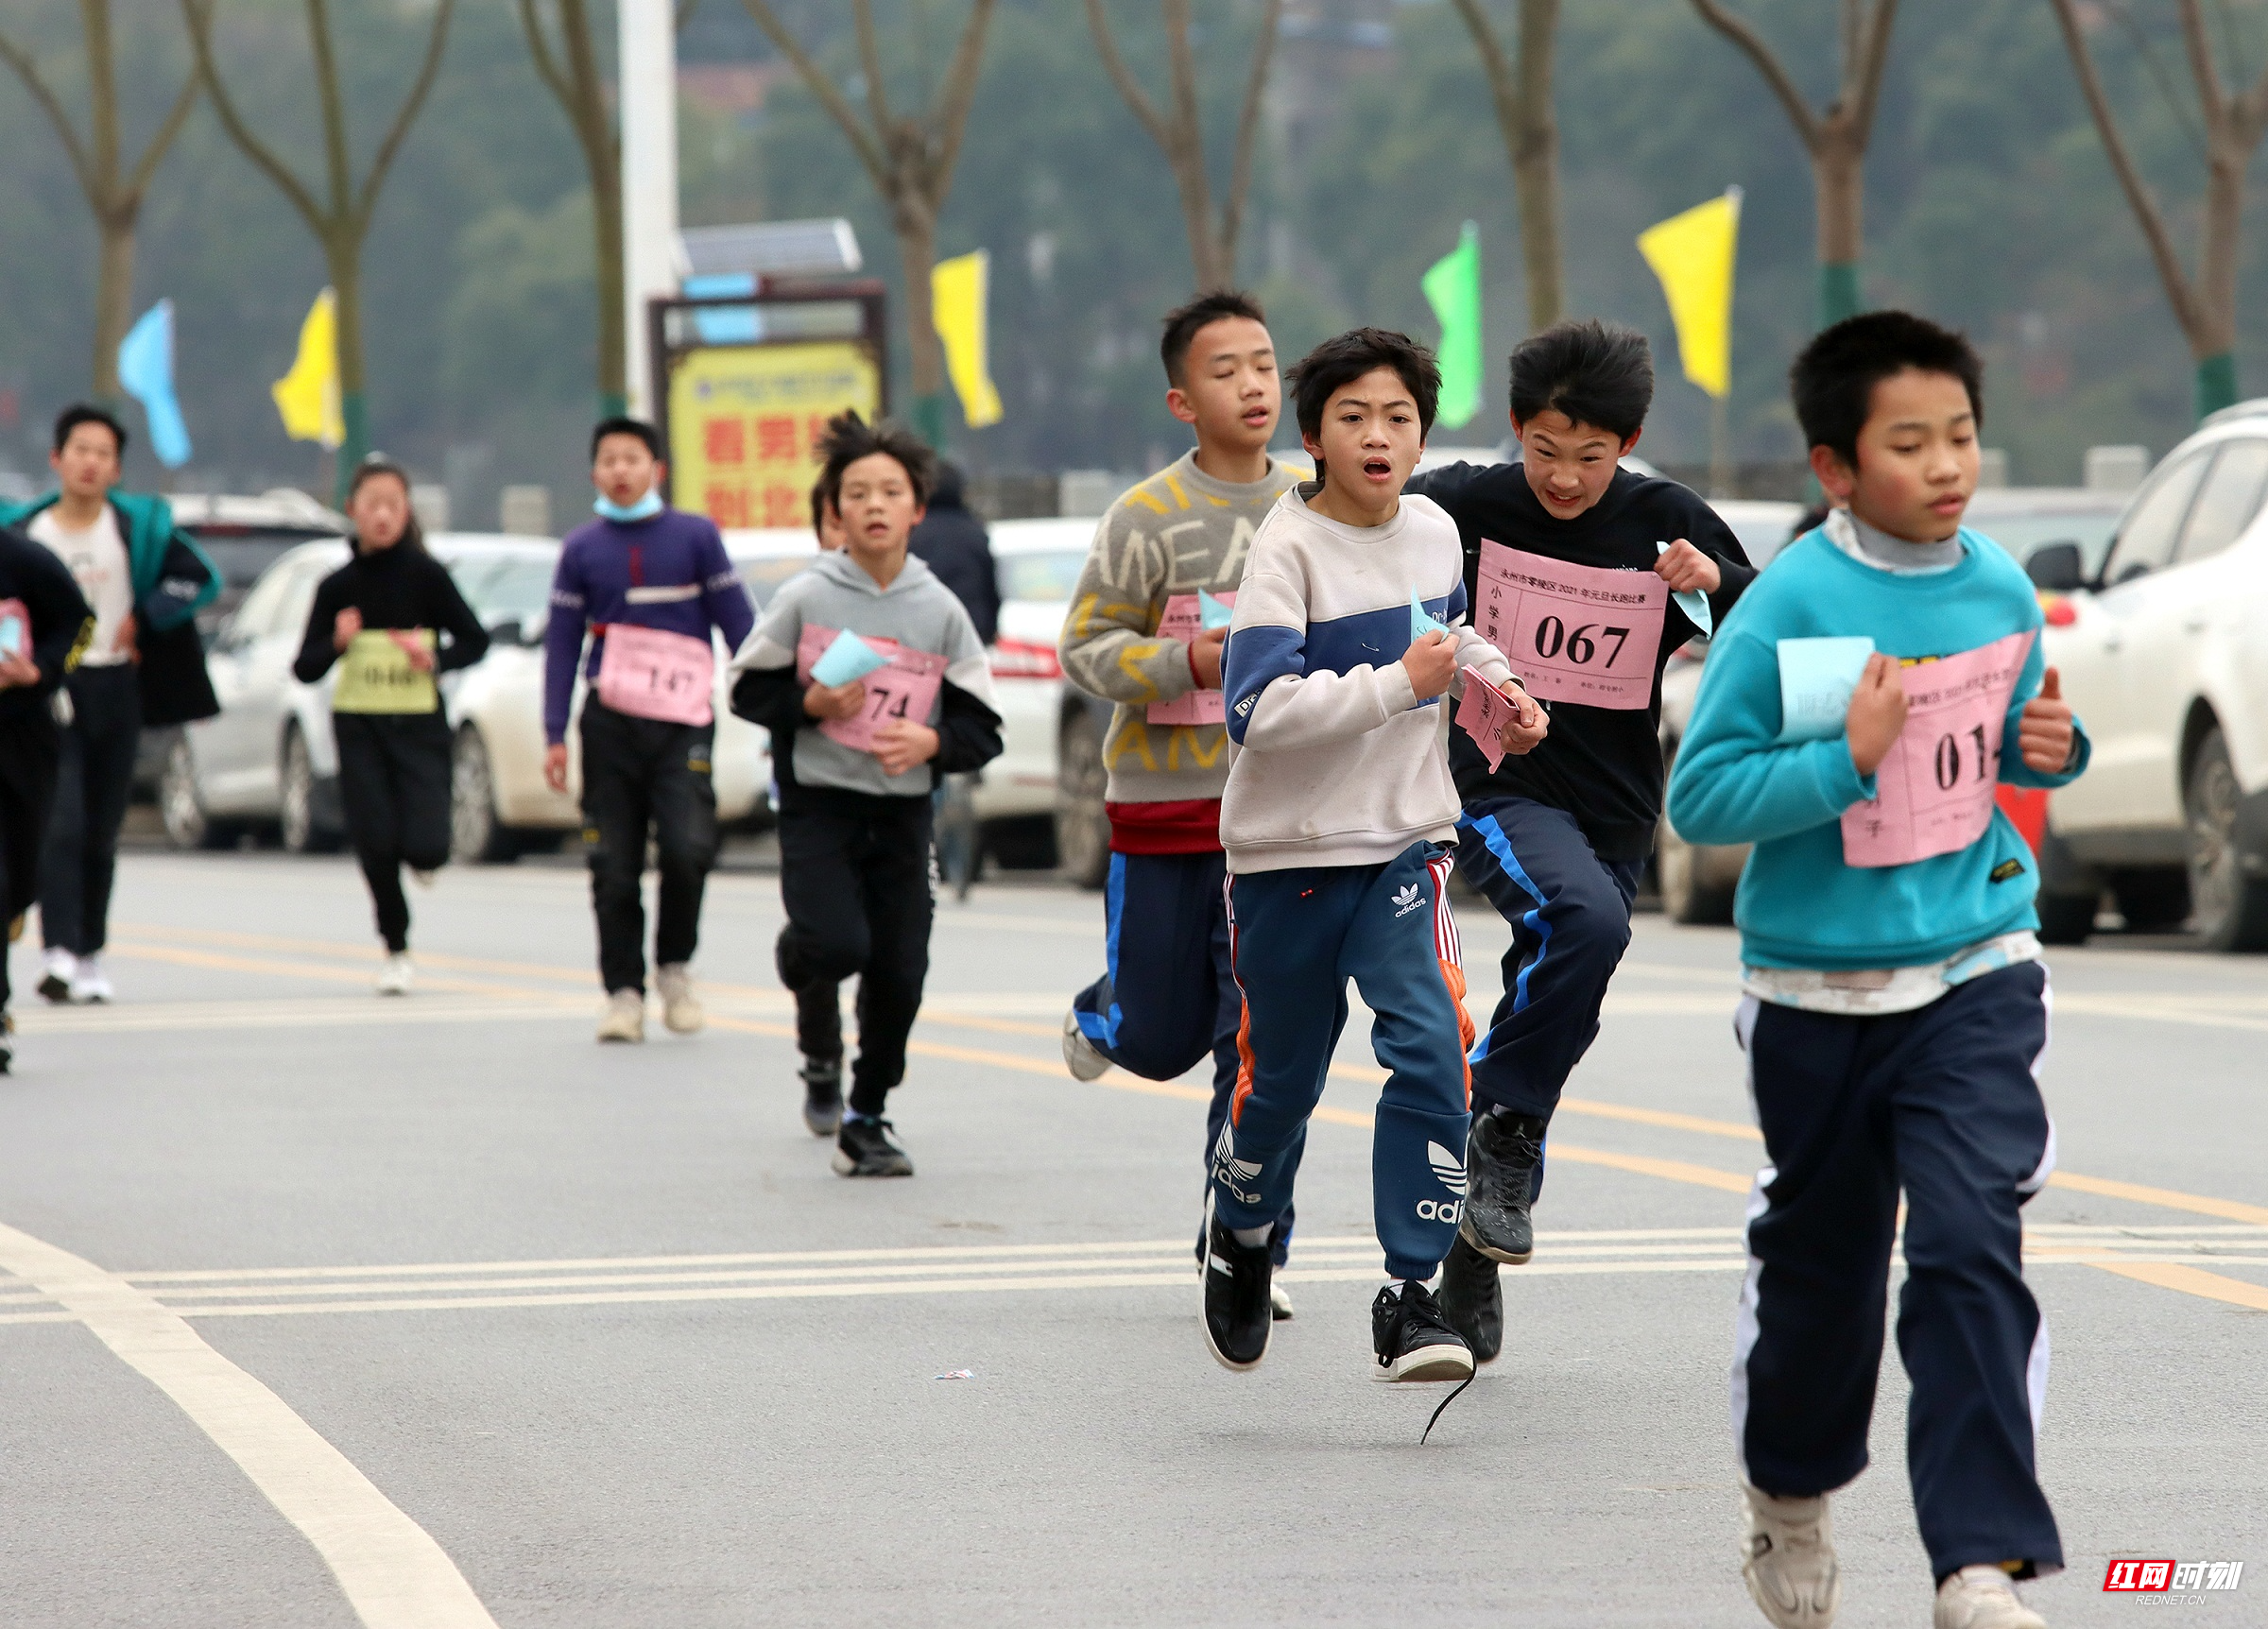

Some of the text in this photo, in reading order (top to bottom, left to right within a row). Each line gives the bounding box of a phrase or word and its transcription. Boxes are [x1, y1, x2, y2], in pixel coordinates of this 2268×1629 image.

[1500, 568, 1556, 592] 永州市零陵区
[1558, 584, 1578, 595] 2021
[1535, 615, 1631, 669] 067
[871, 684, 911, 722] 74
[1933, 723, 2001, 792] 01
[1395, 898, 1427, 918] adidas
[1211, 1155, 1263, 1205] idas
